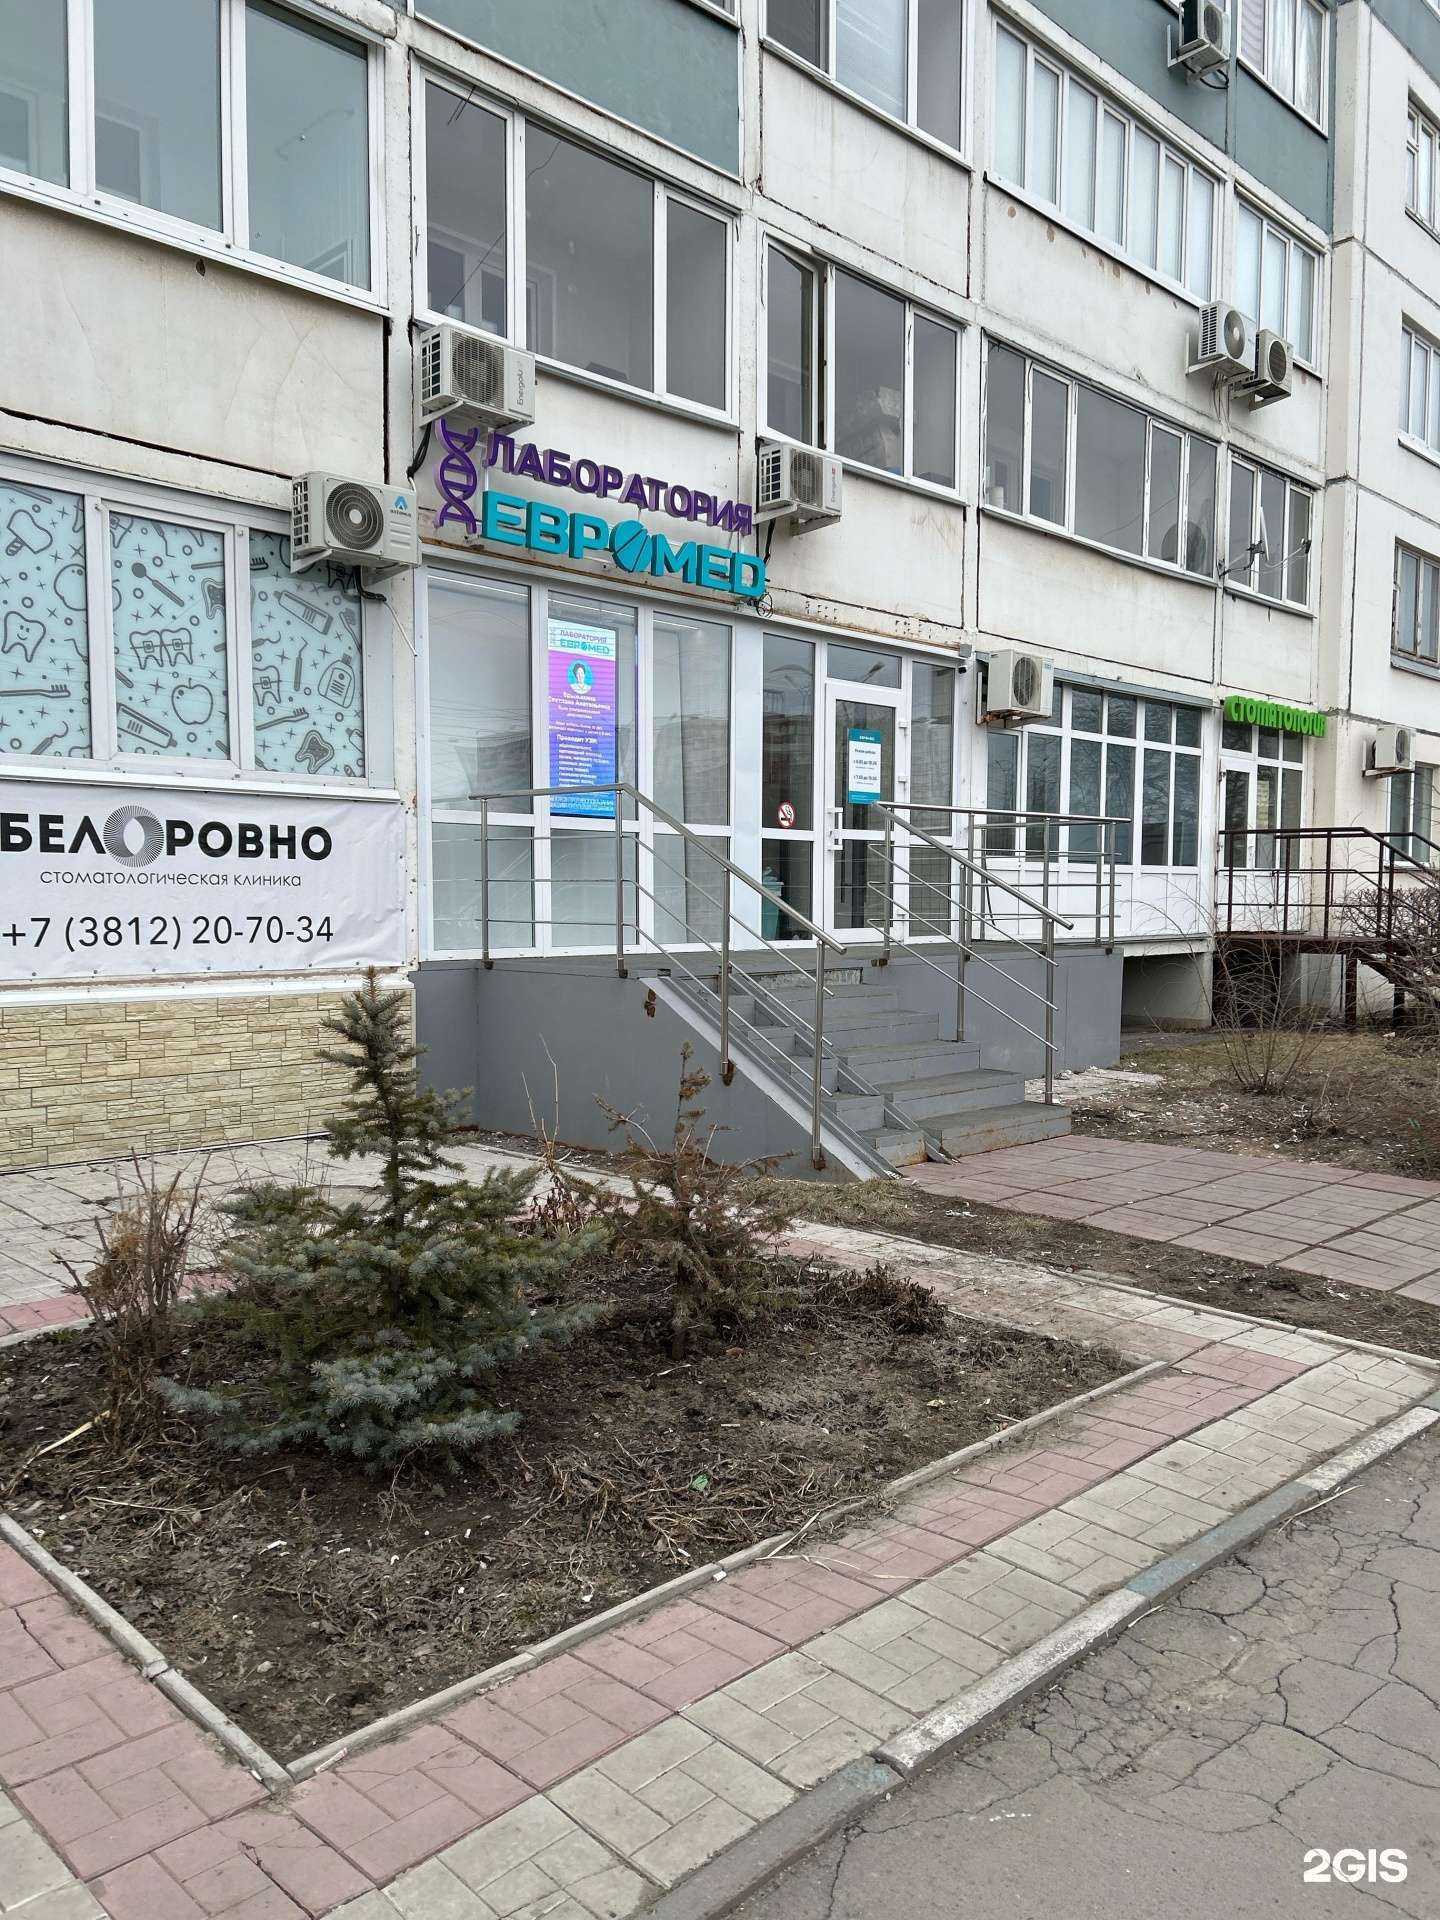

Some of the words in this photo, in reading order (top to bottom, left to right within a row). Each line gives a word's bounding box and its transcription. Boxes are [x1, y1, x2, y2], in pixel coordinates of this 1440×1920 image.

[483, 431, 752, 536] ЛАБОРАТОРИЯ
[560, 630, 608, 643] ЛАБОРАТОРИЯ
[40, 870, 228, 887] стоматологическая
[233, 873, 301, 887] клиника
[2, 917, 51, 947] +7
[65, 915, 181, 951] (3812)
[192, 915, 334, 944] 20-70-34
